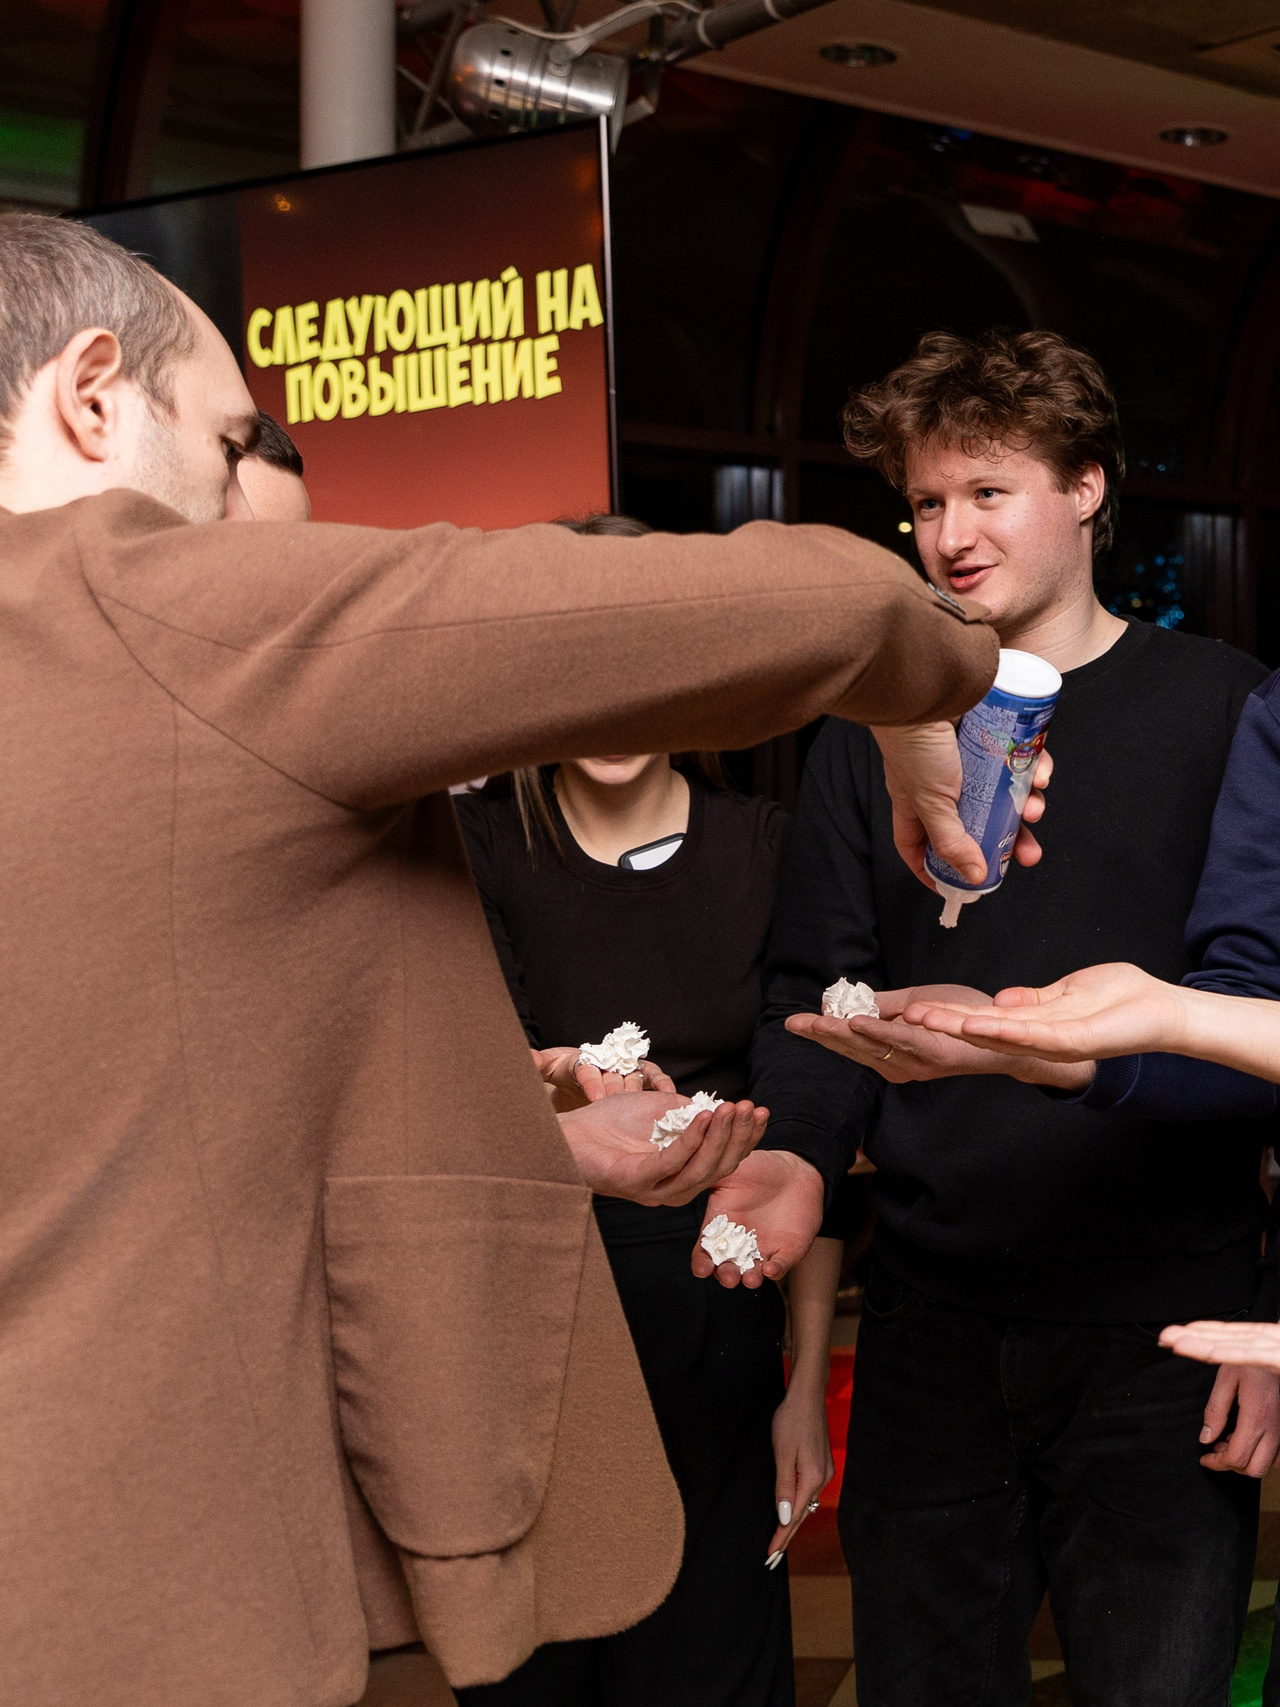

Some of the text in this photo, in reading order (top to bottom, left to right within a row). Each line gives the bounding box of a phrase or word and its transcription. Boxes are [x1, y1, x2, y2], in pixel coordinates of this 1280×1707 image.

[247, 263, 604, 368] СЛЕДУЮЩИЙ НА
[285, 333, 563, 425] ПОВЫШЕНИЕ
